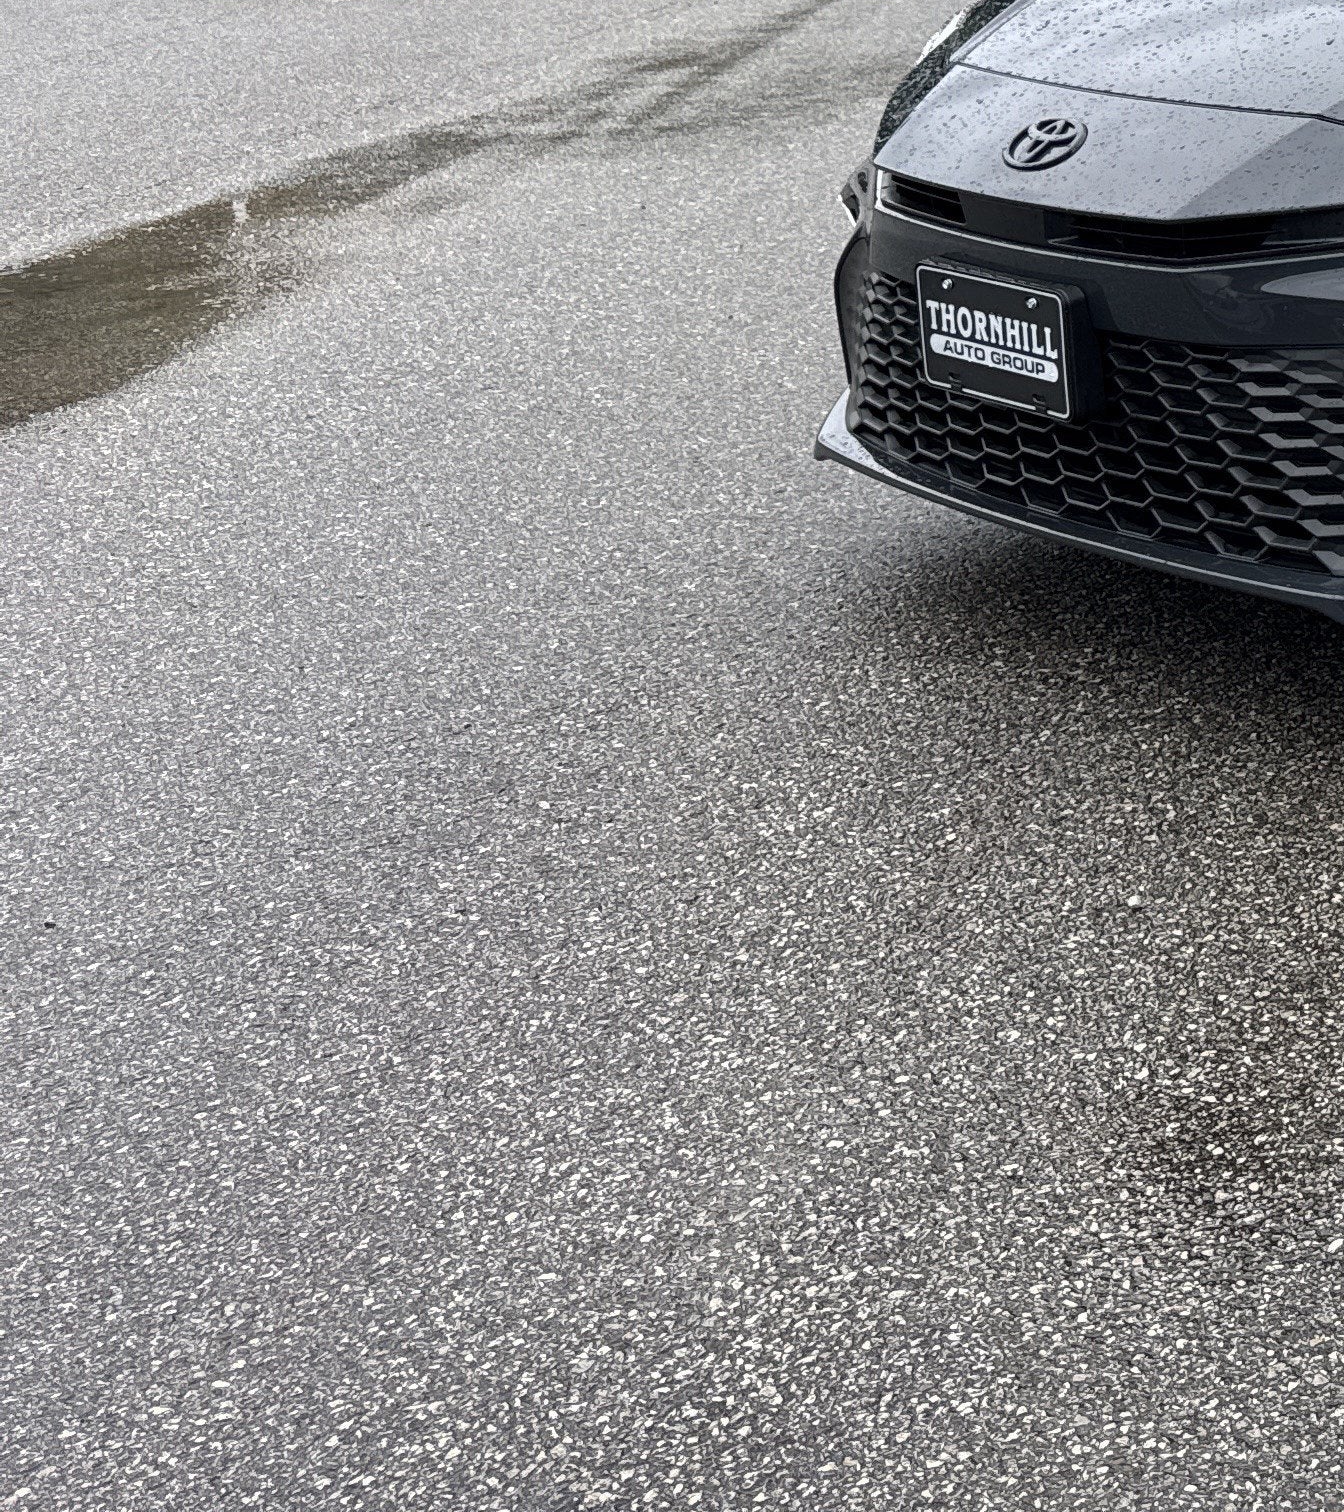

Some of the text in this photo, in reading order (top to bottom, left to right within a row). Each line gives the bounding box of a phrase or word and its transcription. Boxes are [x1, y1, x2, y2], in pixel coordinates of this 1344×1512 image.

[925, 299, 1059, 360] THORNHILL
[943, 339, 1046, 376] AUTO GROUP
